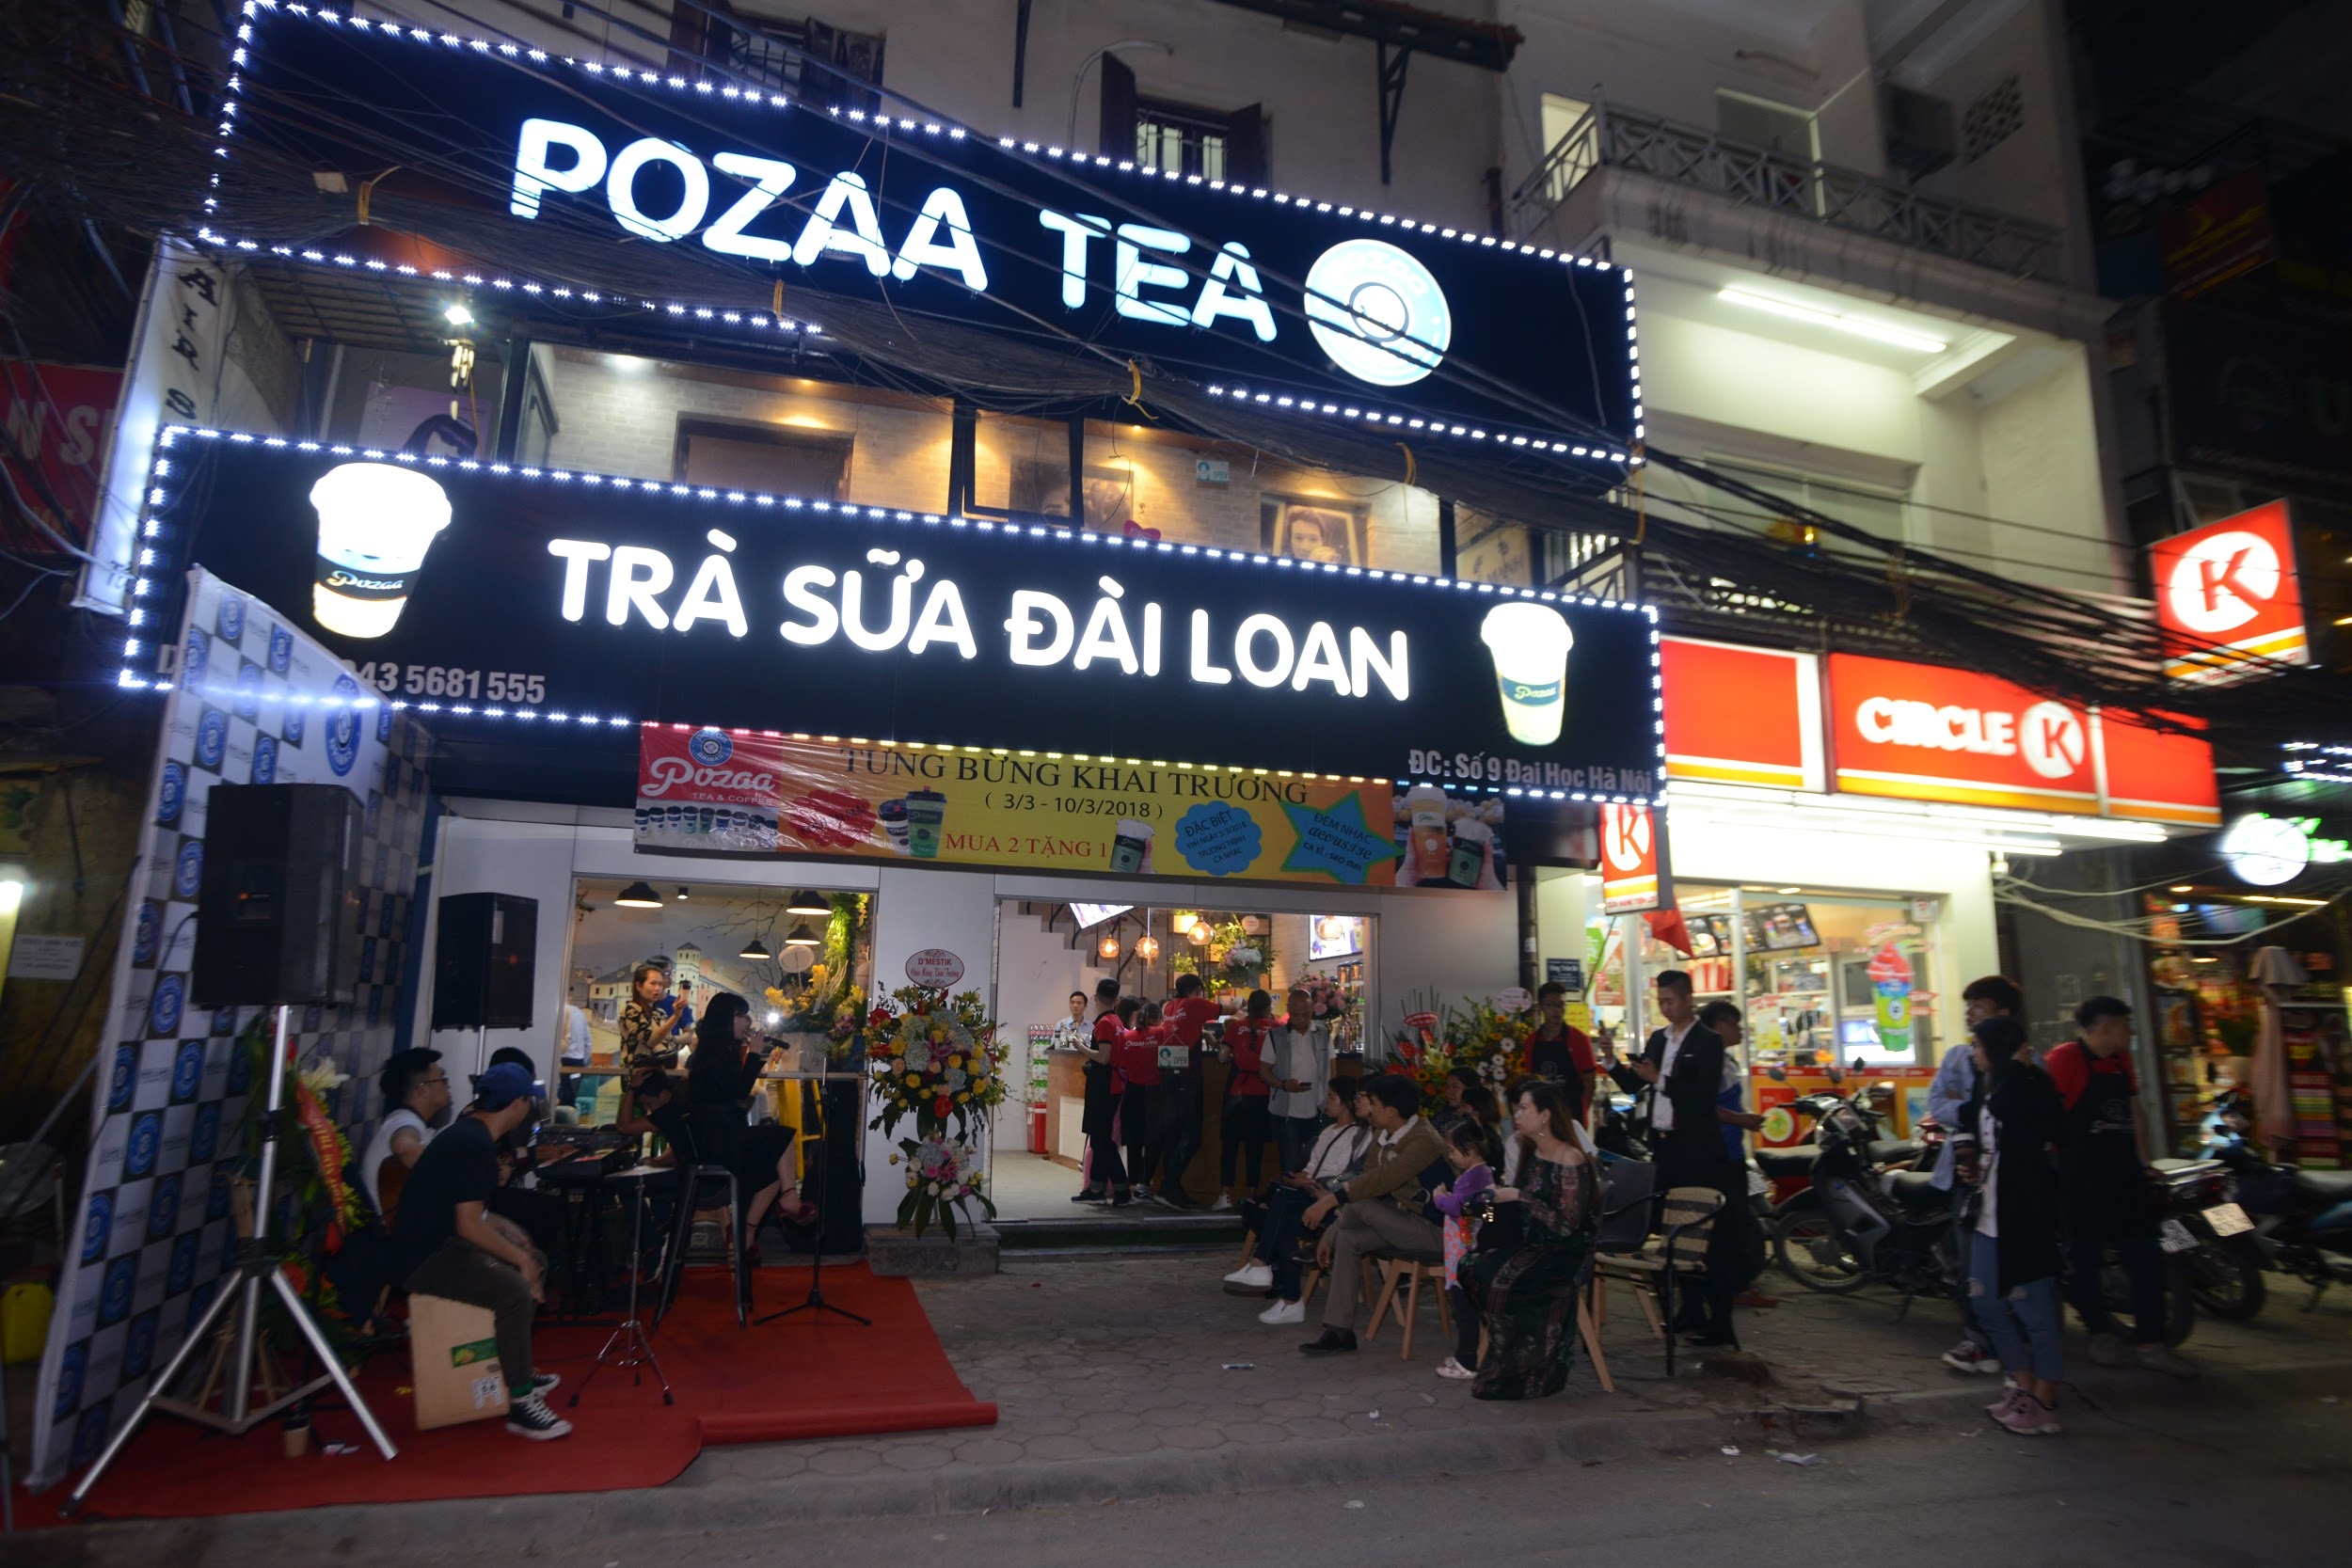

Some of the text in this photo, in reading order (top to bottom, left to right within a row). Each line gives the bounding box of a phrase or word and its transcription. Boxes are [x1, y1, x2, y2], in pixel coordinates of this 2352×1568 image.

[509, 117, 1278, 342] POZAA TEA
[326, 570, 405, 590] Pozaa
[548, 528, 1409, 701] TRÀ SỮA ĐÀI LOAN
[344, 659, 399, 692] 43
[405, 665, 480, 700] 5681
[487, 672, 546, 704] 555
[1856, 696, 2017, 756] CIRCLE
[641, 756, 776, 797] Pozaa
[1072, 763, 1159, 795] KHAI
[1168, 770, 1309, 805] TRƯƠNG
[1455, 751, 1486, 780] Số
[1487, 756, 1502, 782] 9
[692, 792, 714, 800] TEA
[1004, 795, 1035, 812] 3/3
[1055, 797, 1151, 817] 10/3/2018
[946, 832, 1000, 854] MUA
[1008, 837, 1019, 853] 2
[1100, 843, 1106, 858] 1
[1173, 1056, 1188, 1065] OPEN
